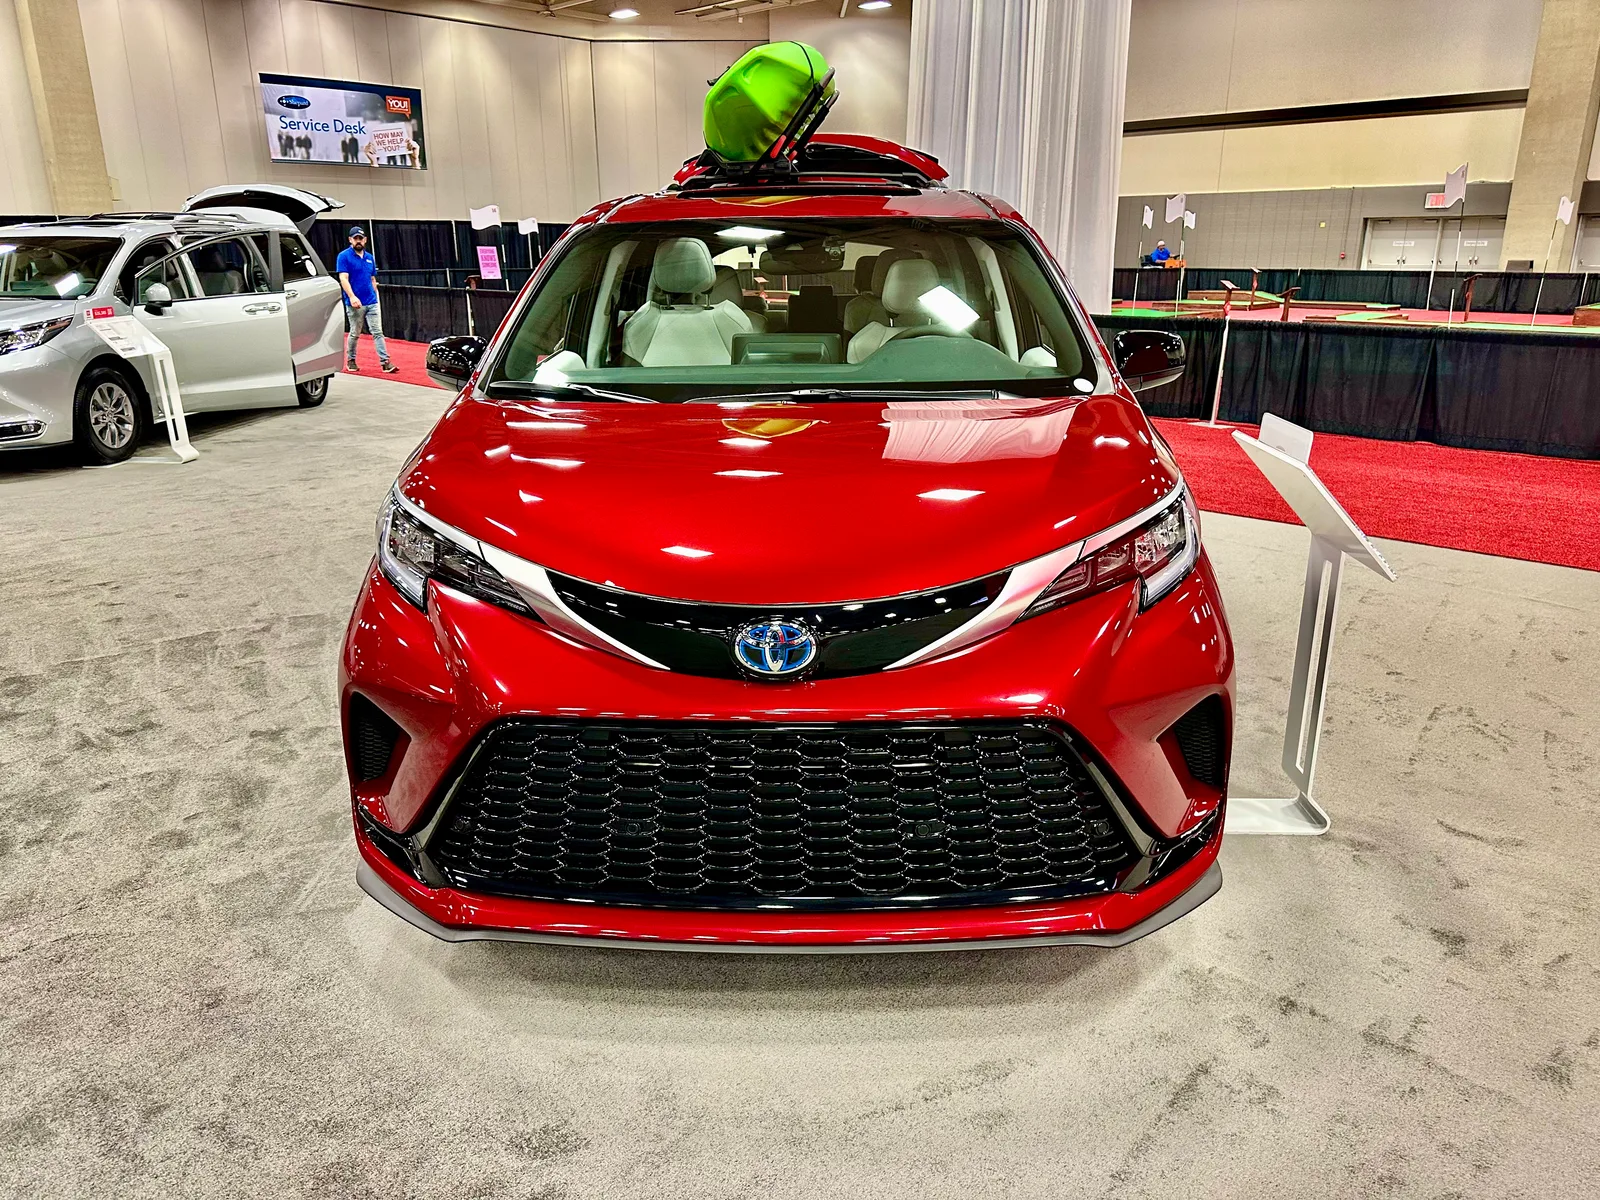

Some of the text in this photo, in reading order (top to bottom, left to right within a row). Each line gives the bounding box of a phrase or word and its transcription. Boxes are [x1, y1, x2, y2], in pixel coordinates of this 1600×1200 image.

[387, 99, 408, 109] YOU!
[279, 115, 367, 135] Service Desk
[373, 132, 390, 140] HOW
[387, 137, 404, 145] HELP
